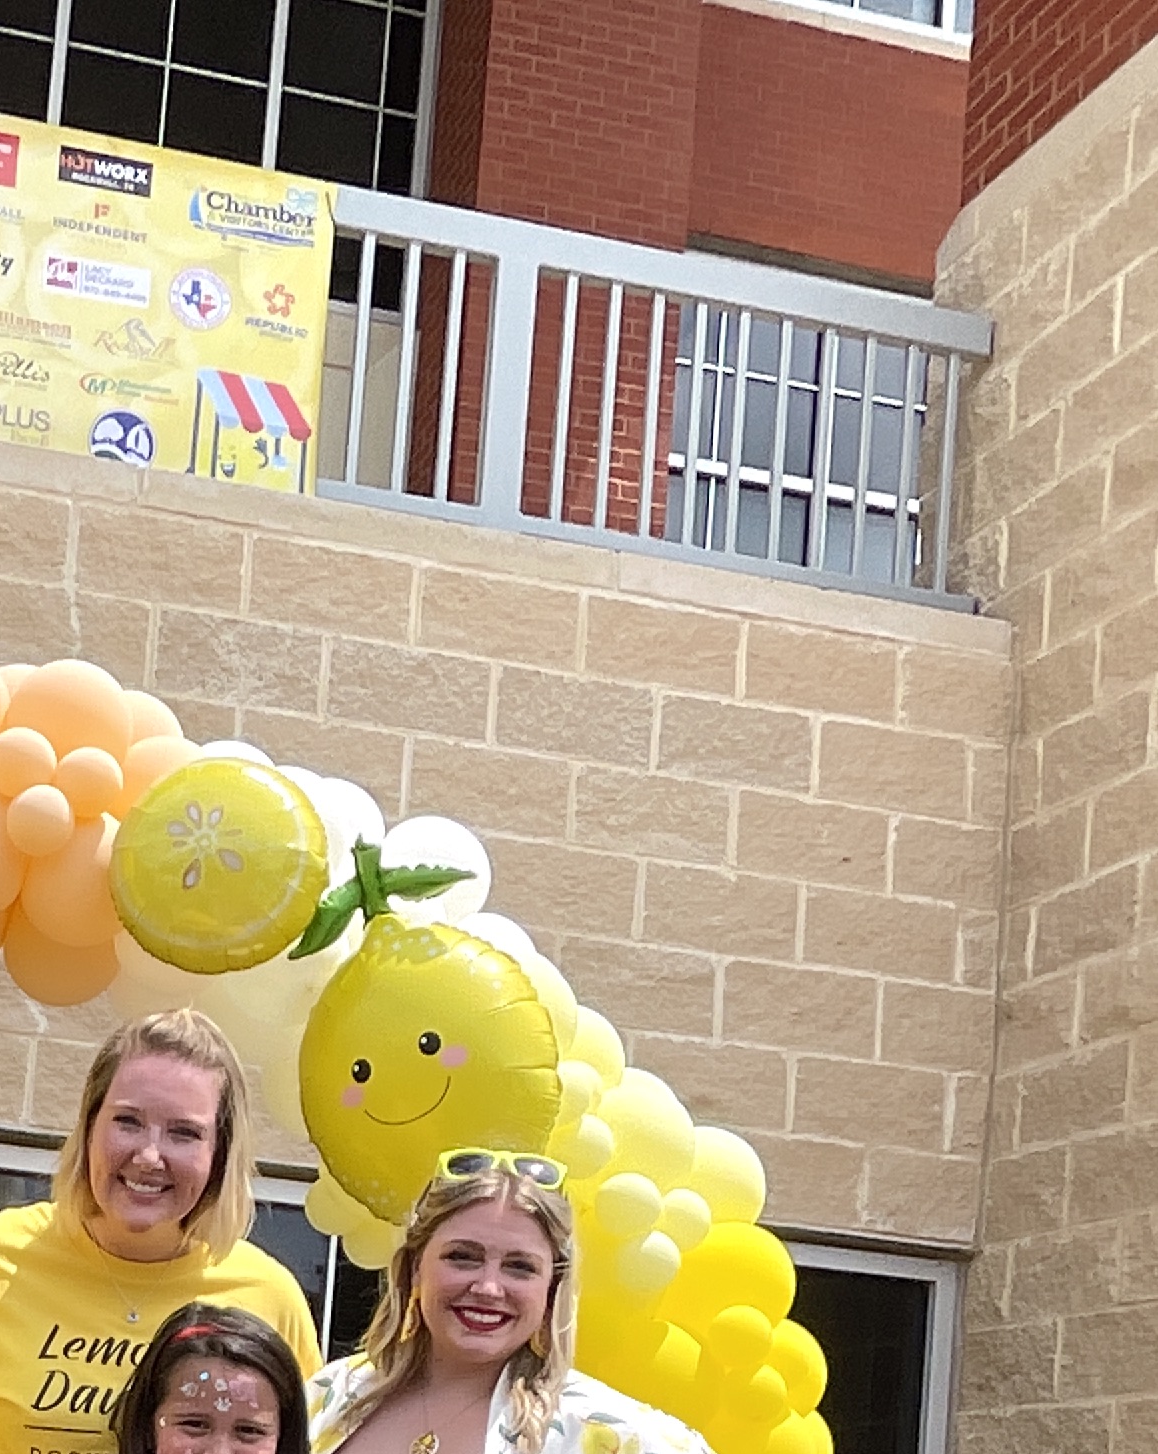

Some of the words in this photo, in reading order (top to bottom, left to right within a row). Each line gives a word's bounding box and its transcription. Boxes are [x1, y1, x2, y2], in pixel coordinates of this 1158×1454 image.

[206, 190, 317, 228] Chamber
[52, 216, 148, 244] INDEPENDENT
[244, 316, 309, 339] REPUBLIC
